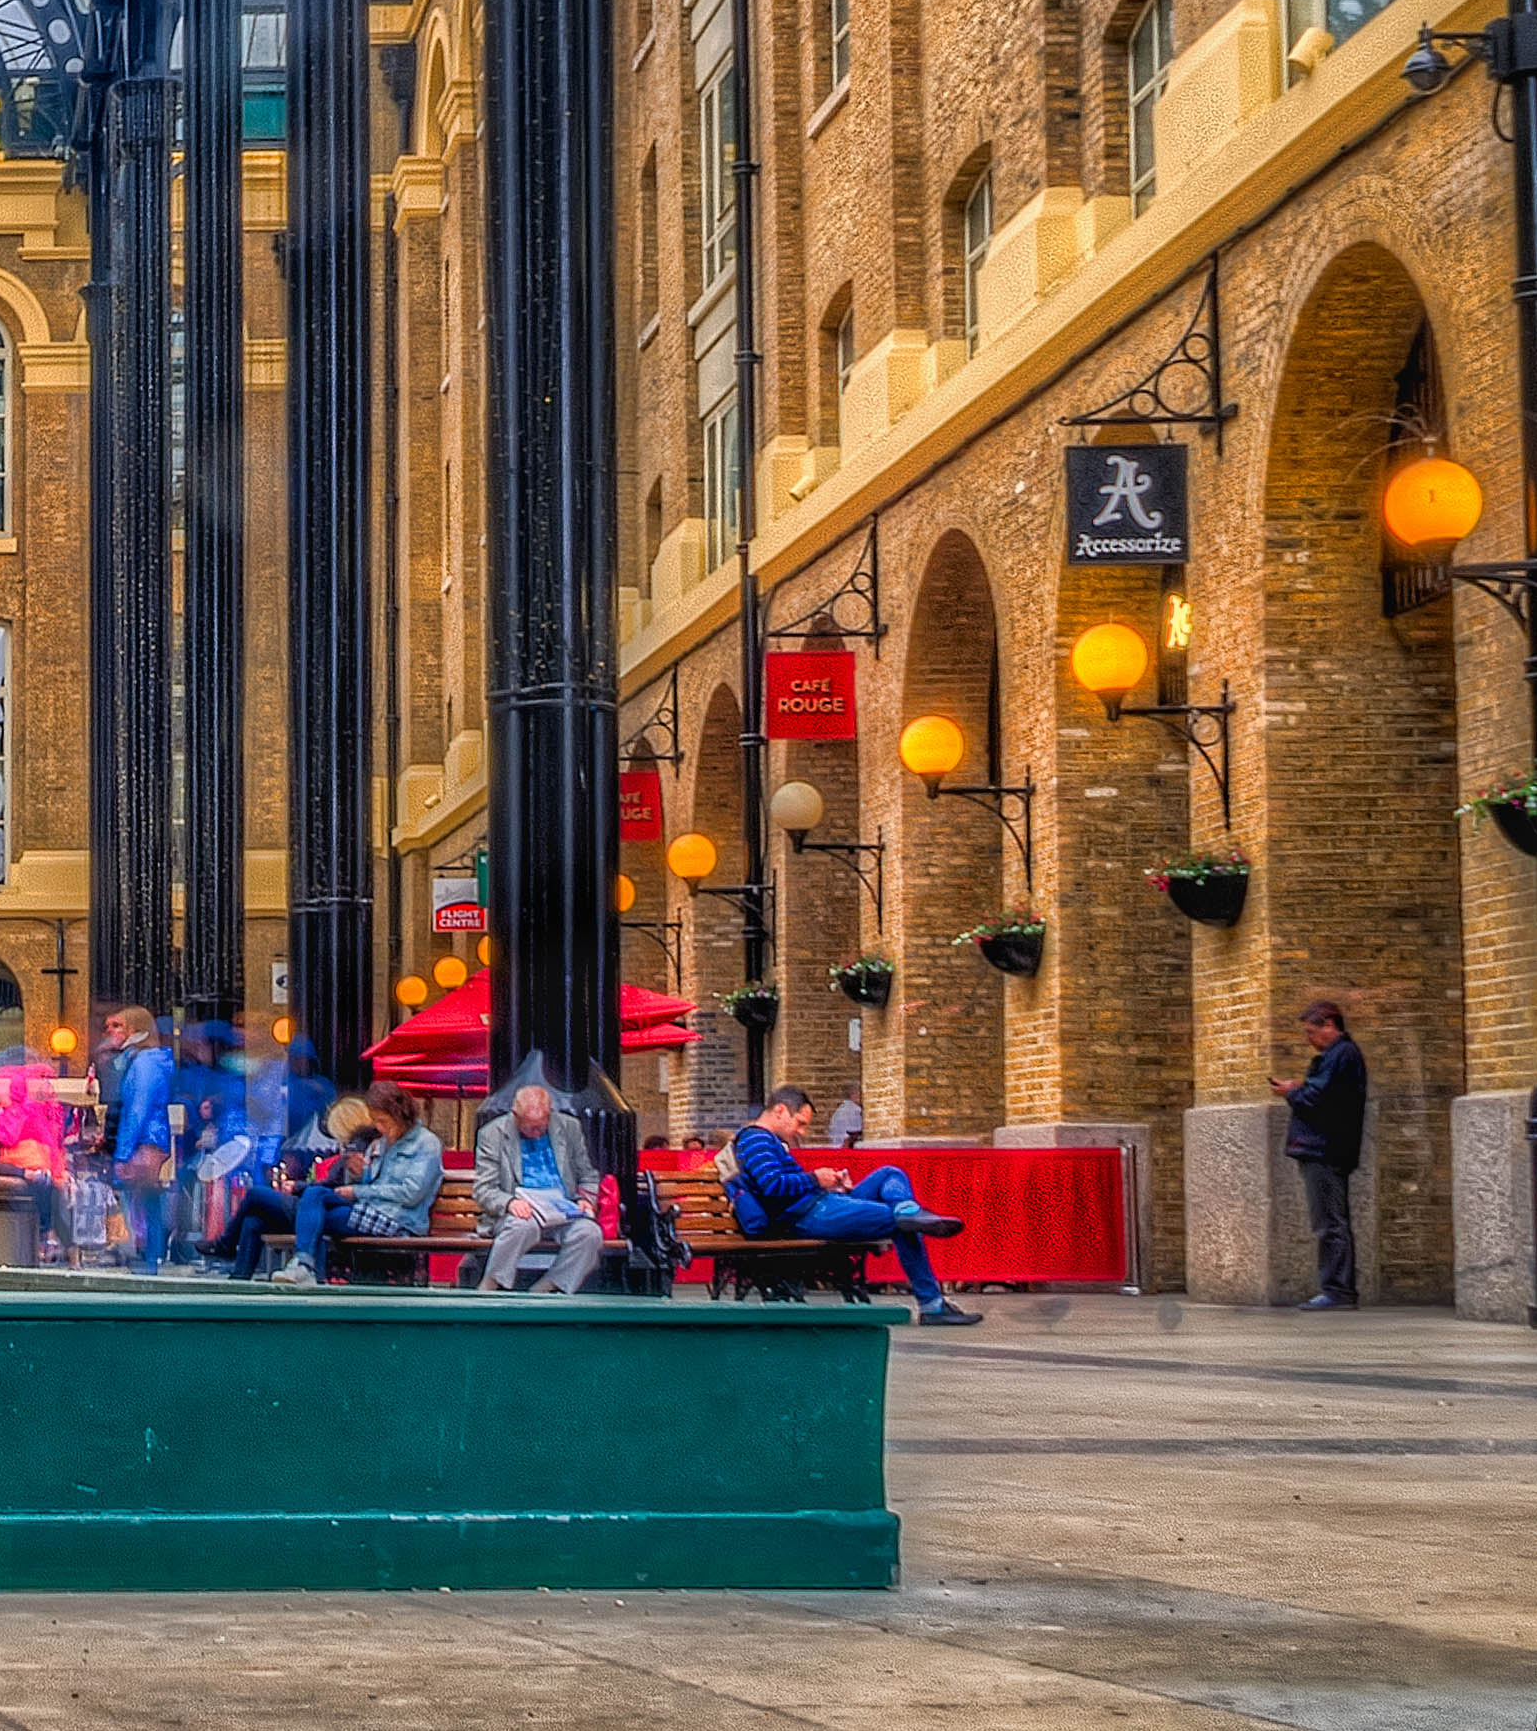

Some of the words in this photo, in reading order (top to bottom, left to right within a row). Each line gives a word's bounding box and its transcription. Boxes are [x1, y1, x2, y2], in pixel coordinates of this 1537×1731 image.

[1093, 455, 1162, 529] A
[1076, 533, 1182, 557] Accessorize
[791, 677, 831, 693] CAFÉ
[778, 697, 845, 713] ROUGE
[620, 807, 652, 821] UGE
[441, 909, 479, 919] FLIGHT
[438, 918, 481, 928] CENTRE
